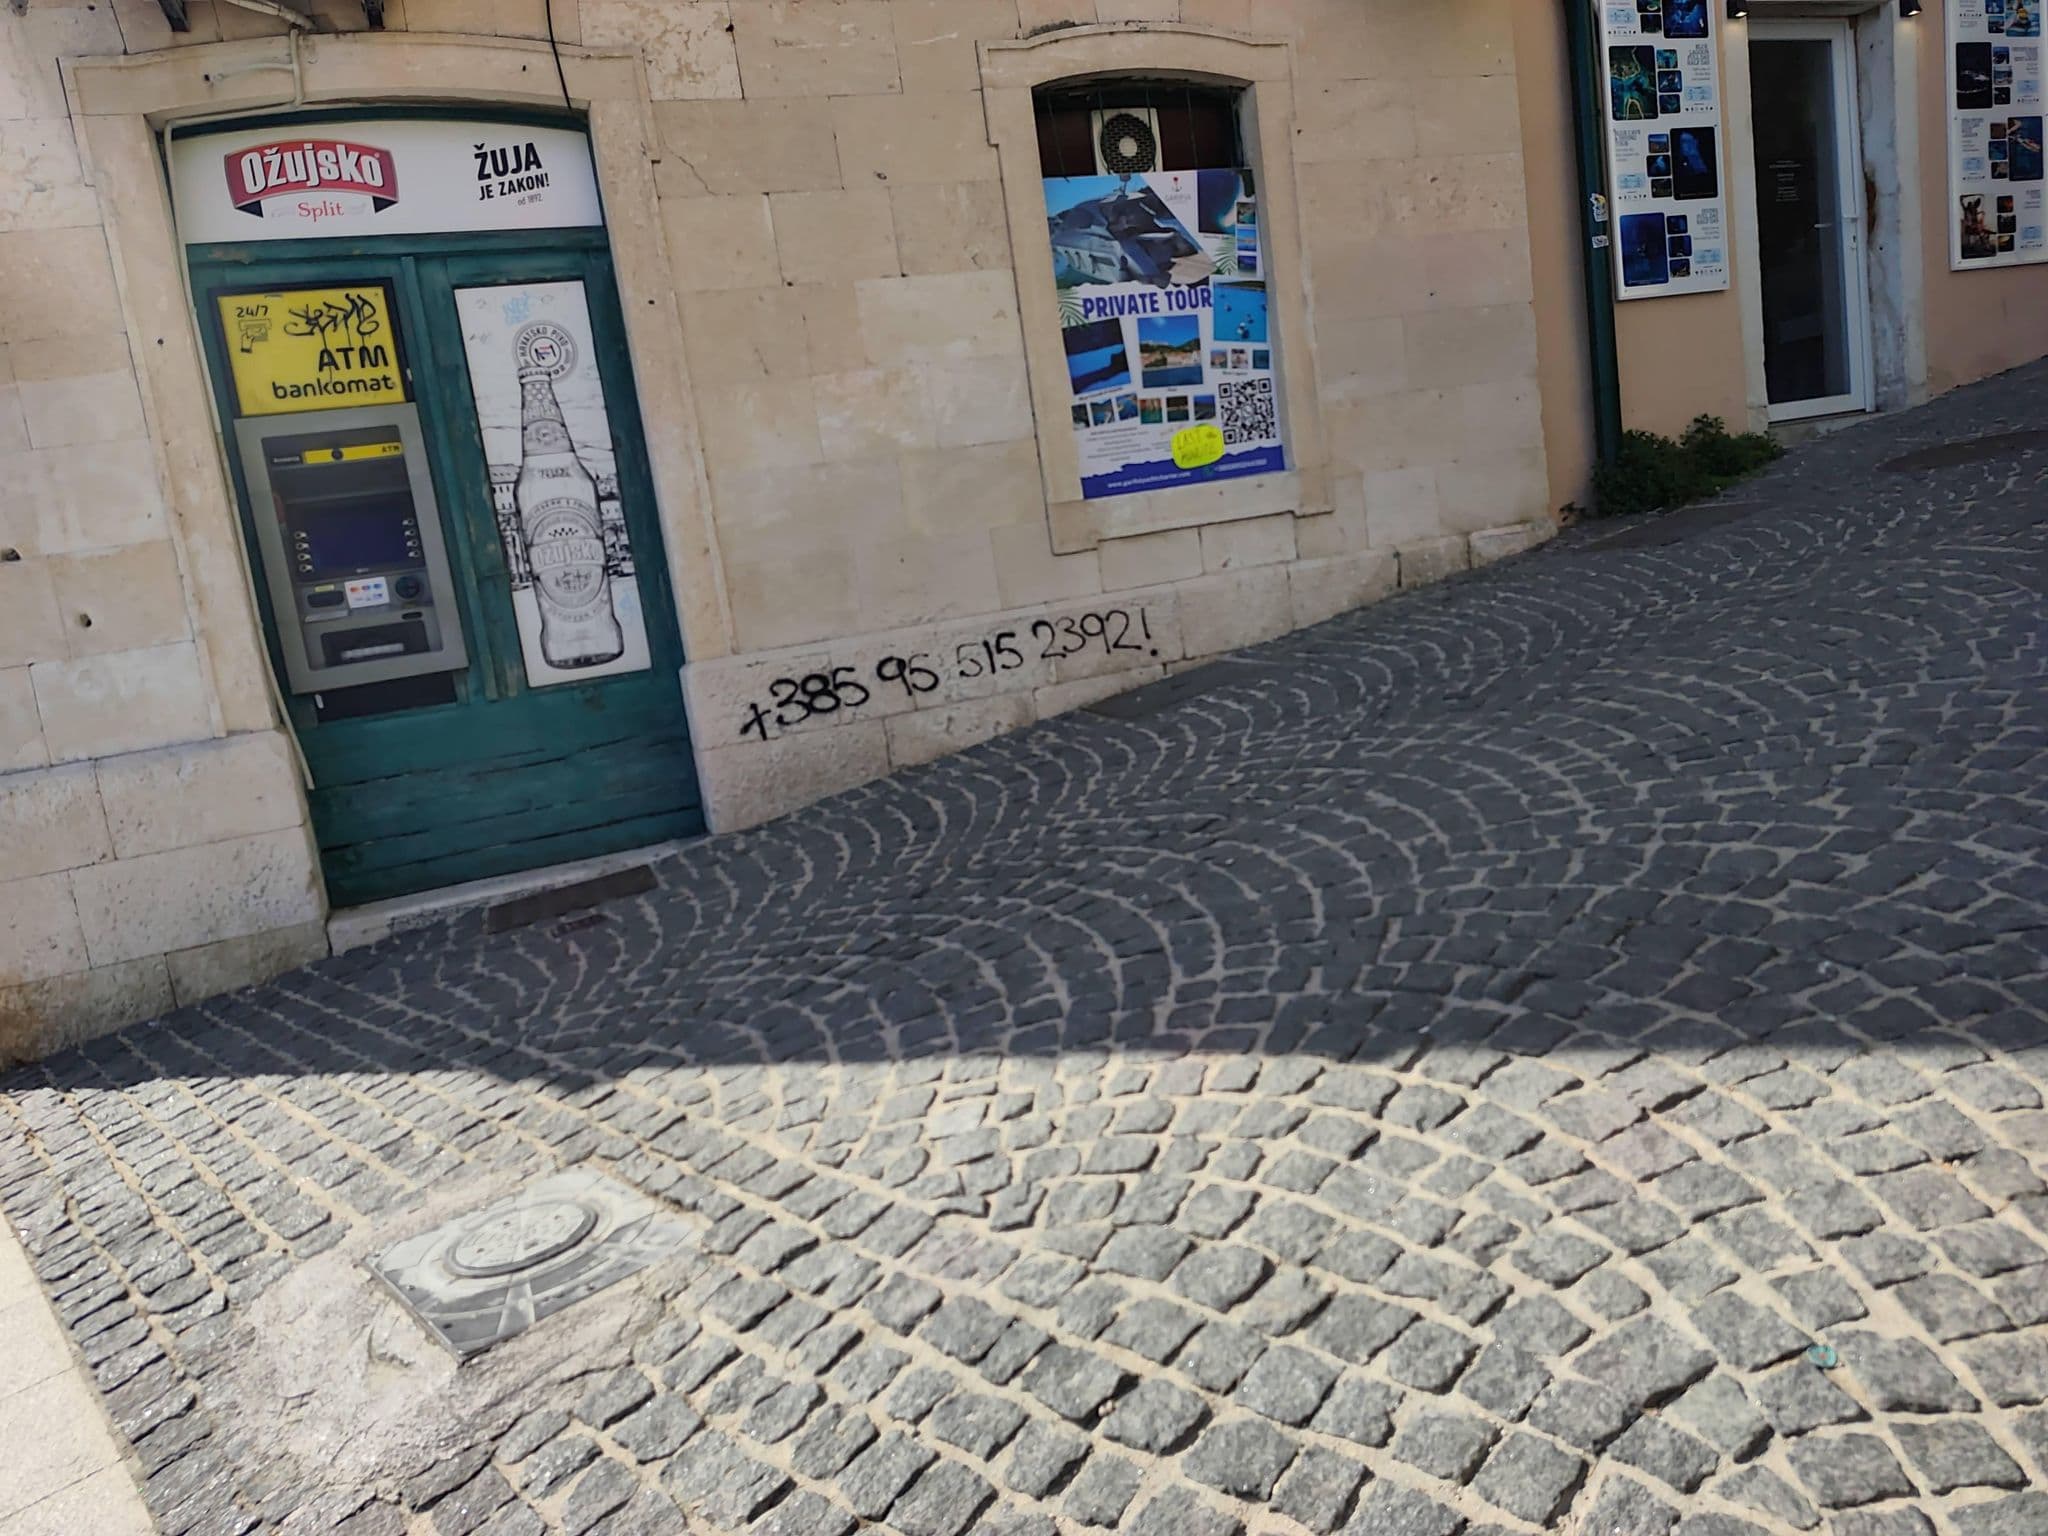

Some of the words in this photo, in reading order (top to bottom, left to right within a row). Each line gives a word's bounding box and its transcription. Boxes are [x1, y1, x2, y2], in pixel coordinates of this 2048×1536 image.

[240, 142, 385, 195] Ožujsko
[473, 142, 542, 181] ŽUJA
[479, 184, 495, 202] JE
[498, 175, 551, 197] ZAKON!
[297, 200, 345, 222] Split
[235, 304, 269, 319] 24/7
[1082, 292, 1160, 319] PRIVATE
[1165, 287, 1213, 311] TOUR
[318, 345, 389, 373] ATM
[272, 374, 395, 400] bankomat
[381, 445, 400, 454] ATM
[739, 666, 869, 741] +385
[876, 653, 939, 696] 95
[956, 631, 1023, 678] 515
[1031, 607, 1158, 660] 2392!
